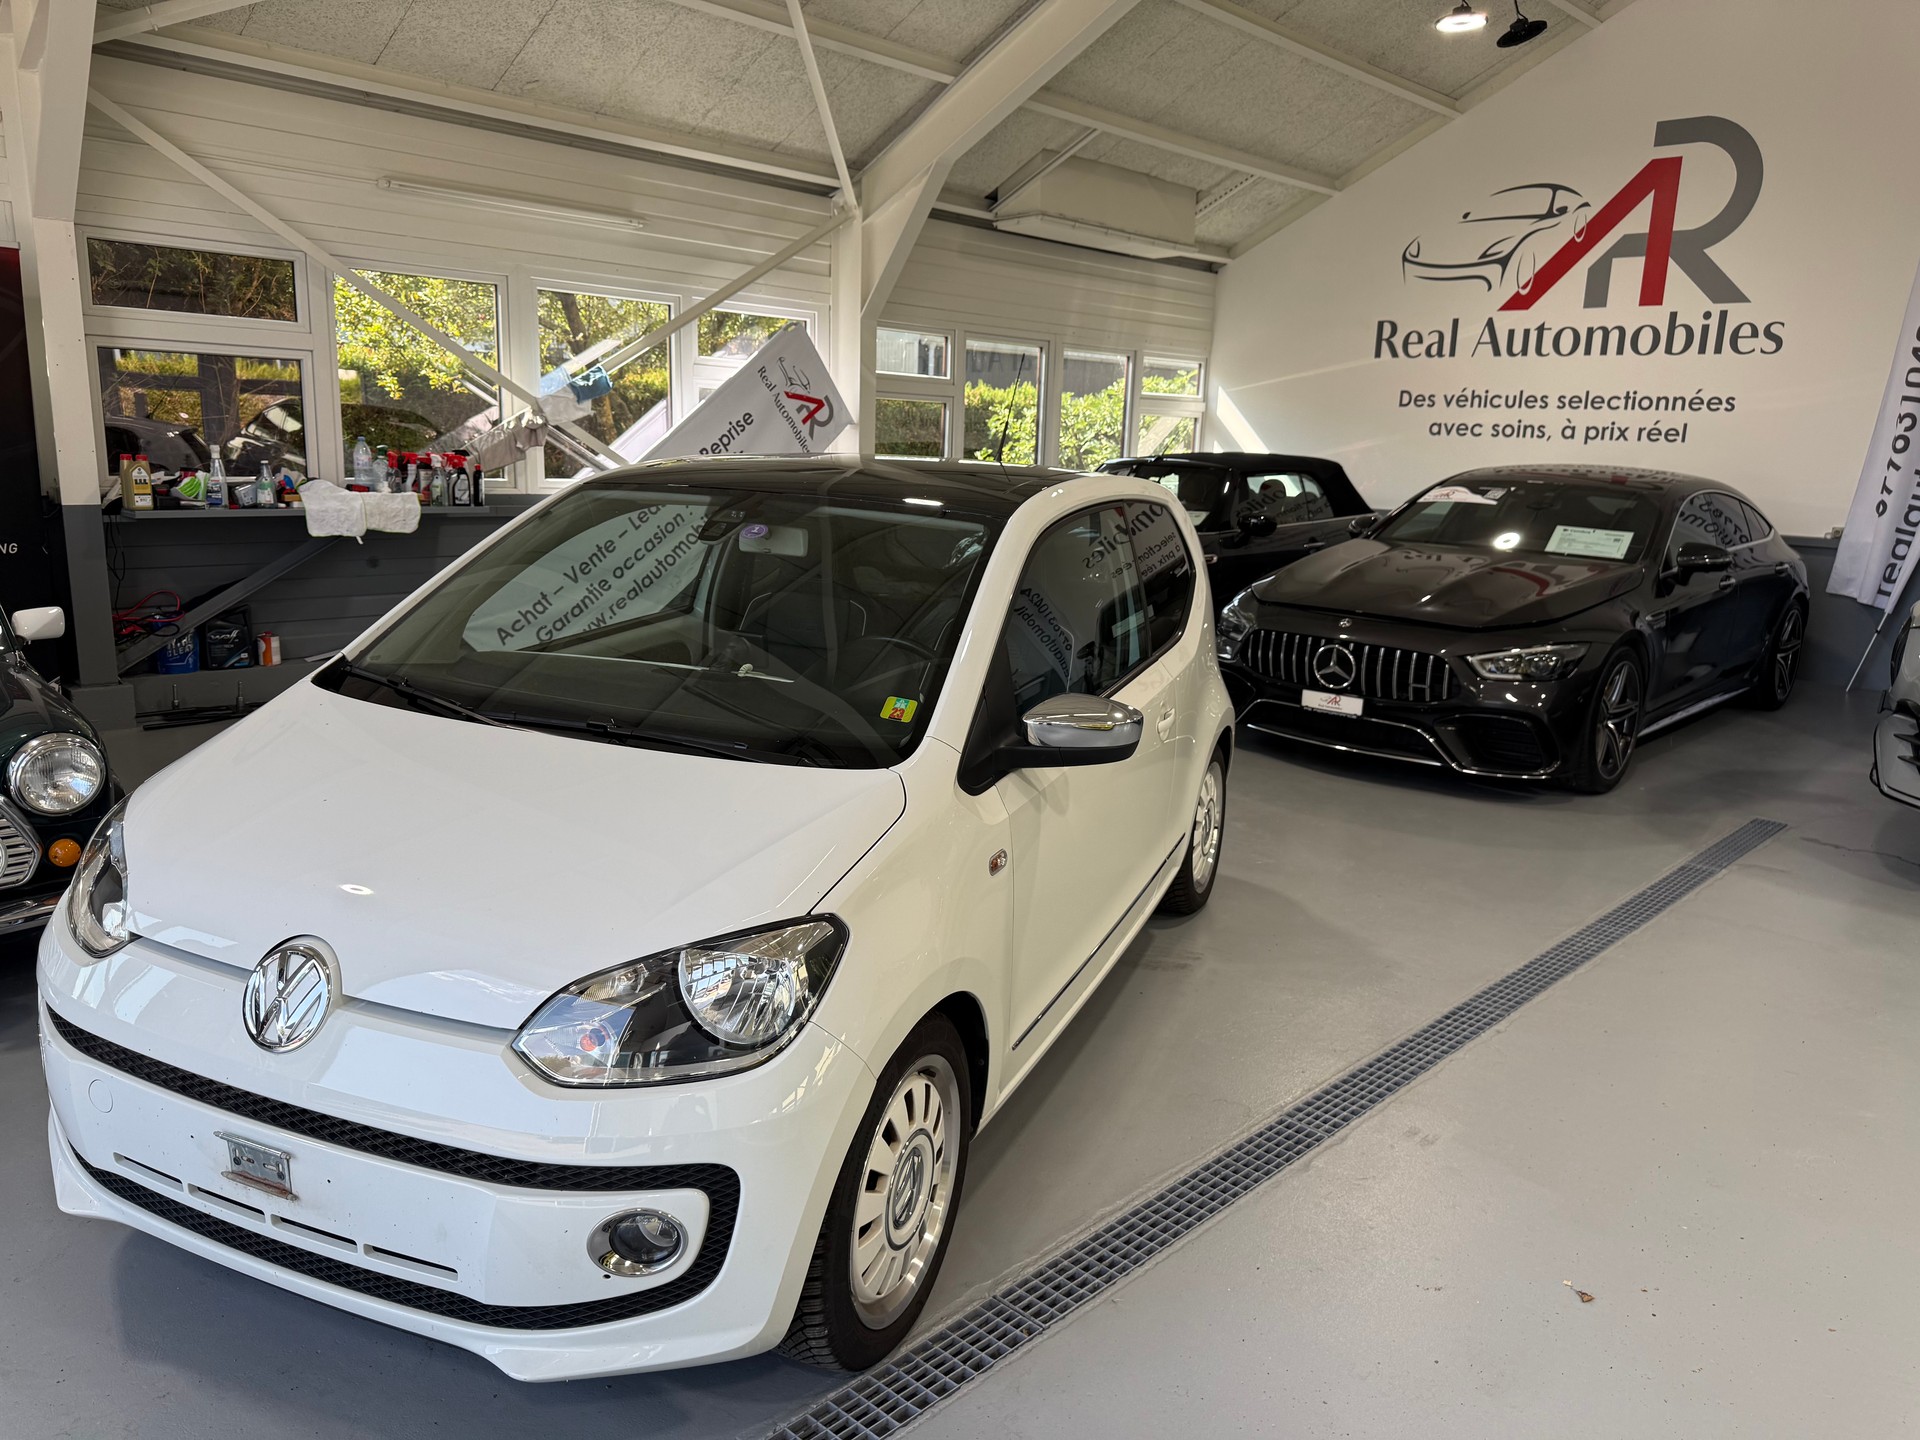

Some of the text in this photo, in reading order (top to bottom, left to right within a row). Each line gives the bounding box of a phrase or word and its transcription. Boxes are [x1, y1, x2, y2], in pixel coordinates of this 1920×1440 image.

[1374, 309, 1786, 359] Real Automobiles
[757, 365, 776, 393] Real
[1399, 387, 1736, 412] Des véhicules selectionnées
[1428, 418, 1688, 445] avec soins, à prix réel
[496, 591, 554, 647] Achat
[563, 538, 617, 585] Vente
[627, 504, 667, 531] Lea
[535, 582, 613, 644] Garantie
[612, 511, 686, 580] occasion
[889, 707, 906, 720] 23
